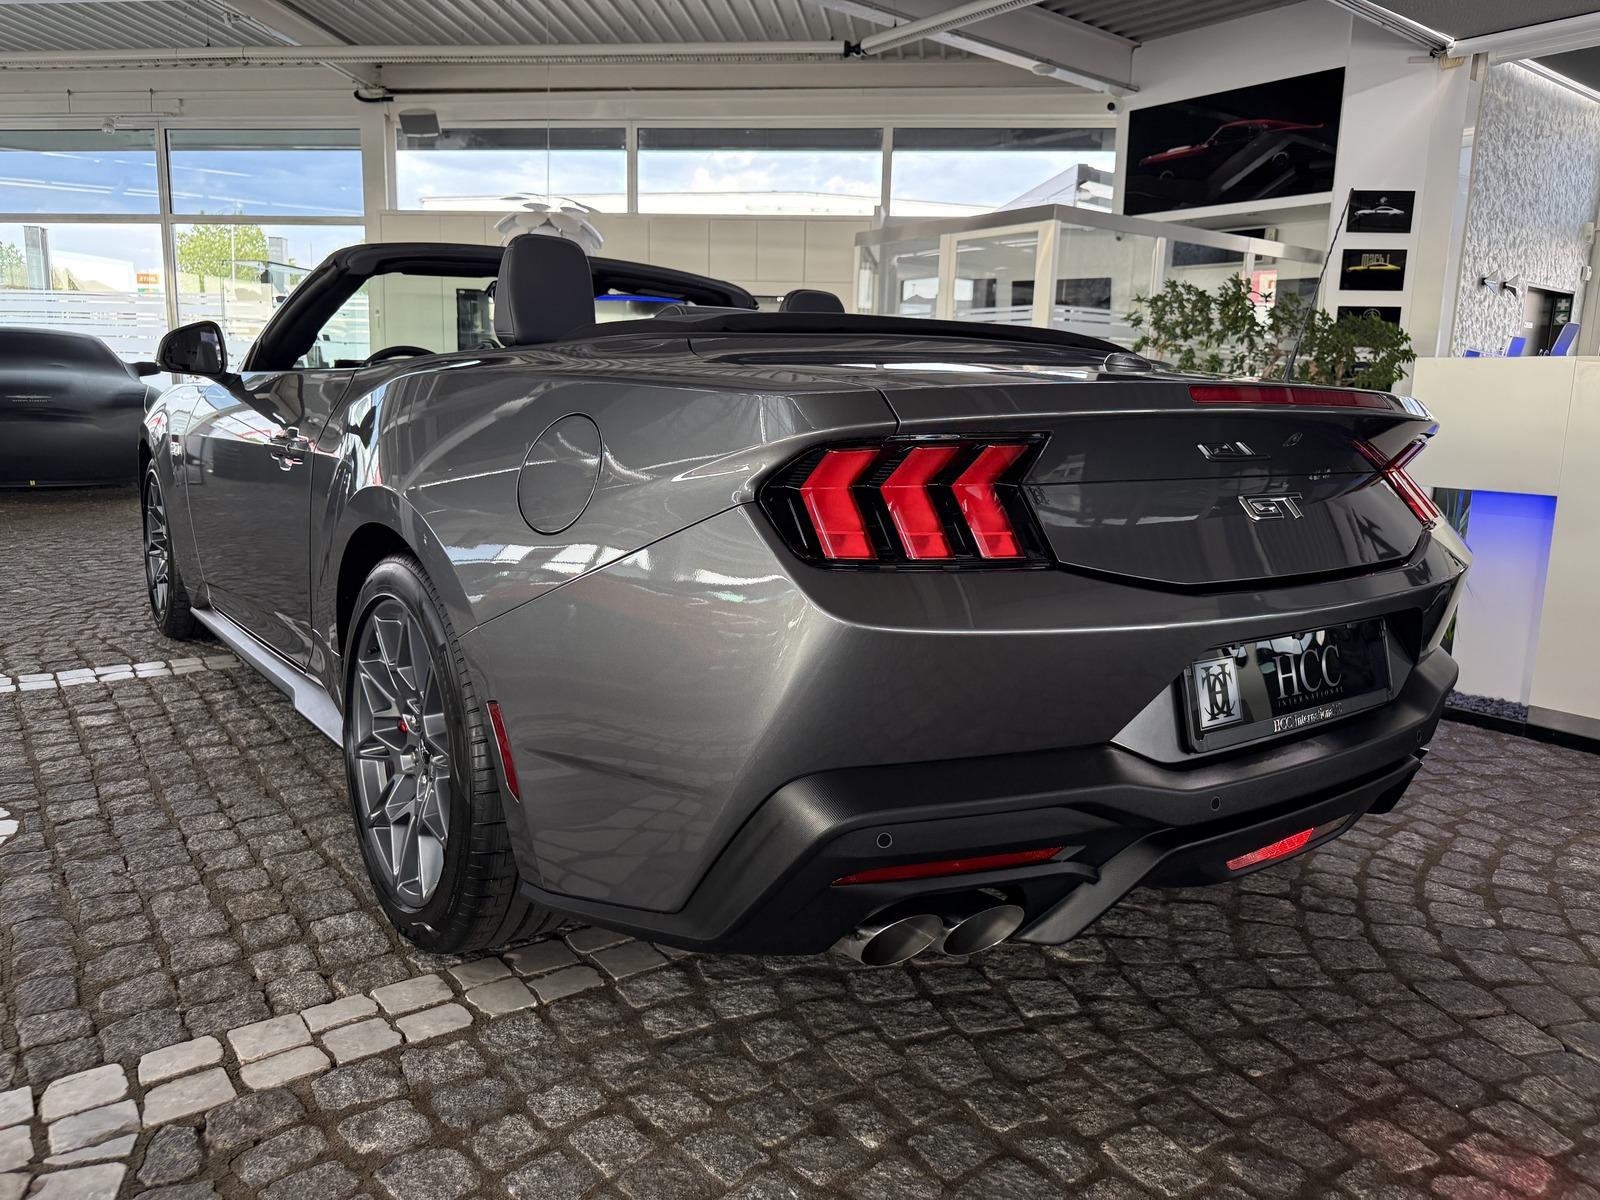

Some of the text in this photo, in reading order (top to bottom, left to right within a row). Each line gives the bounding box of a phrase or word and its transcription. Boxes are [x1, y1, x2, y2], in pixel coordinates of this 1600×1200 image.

[1237, 491, 1304, 522] GT
[1272, 644, 1343, 700] HCC
[1273, 716, 1293, 732] HCC
